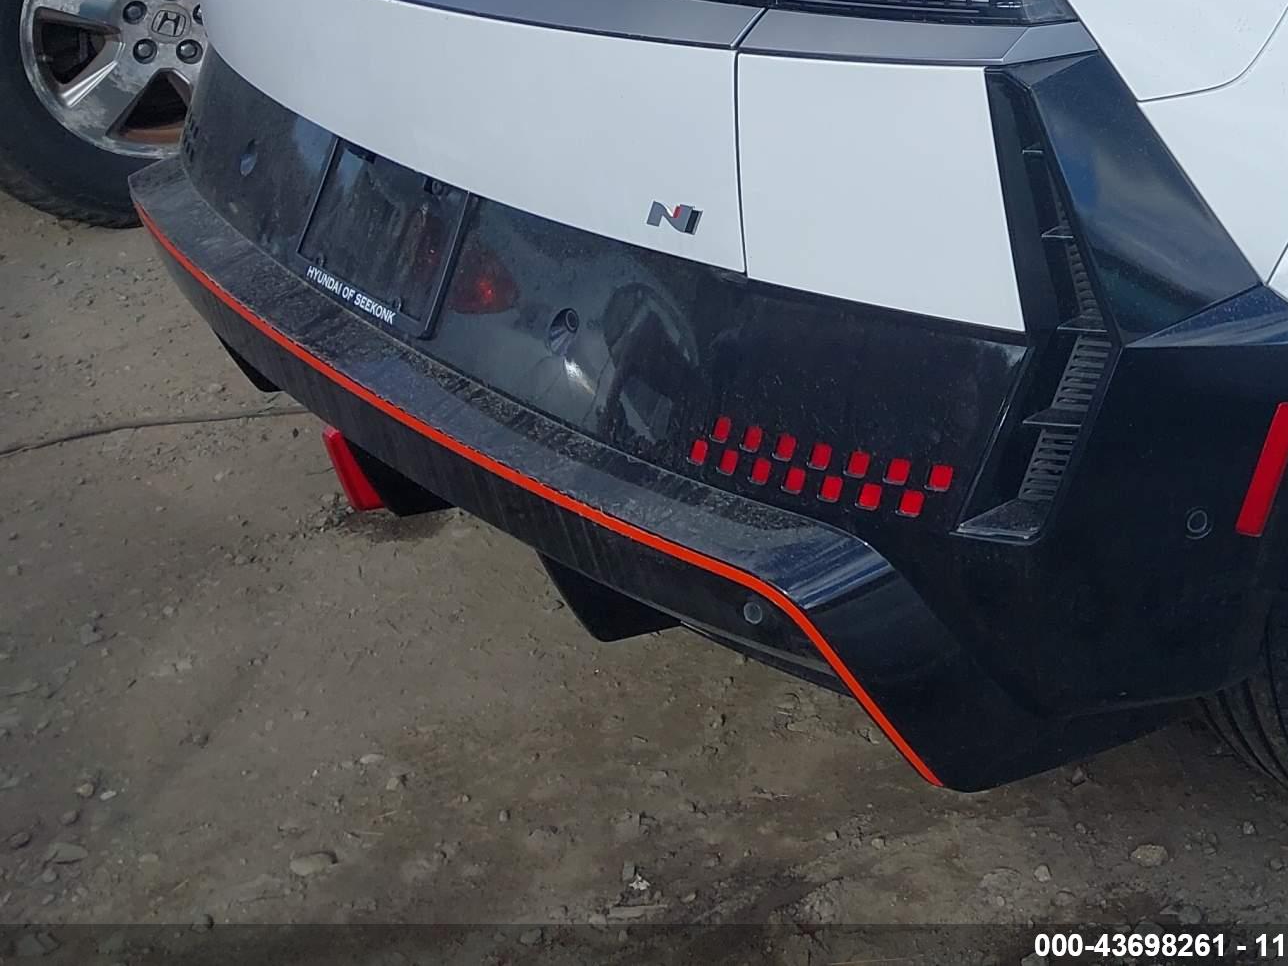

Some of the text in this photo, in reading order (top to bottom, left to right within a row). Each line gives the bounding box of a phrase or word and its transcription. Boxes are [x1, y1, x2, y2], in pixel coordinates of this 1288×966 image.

[646, 200, 703, 235] N
[307, 265, 396, 325] HYUNDAI OF SEEKONK
